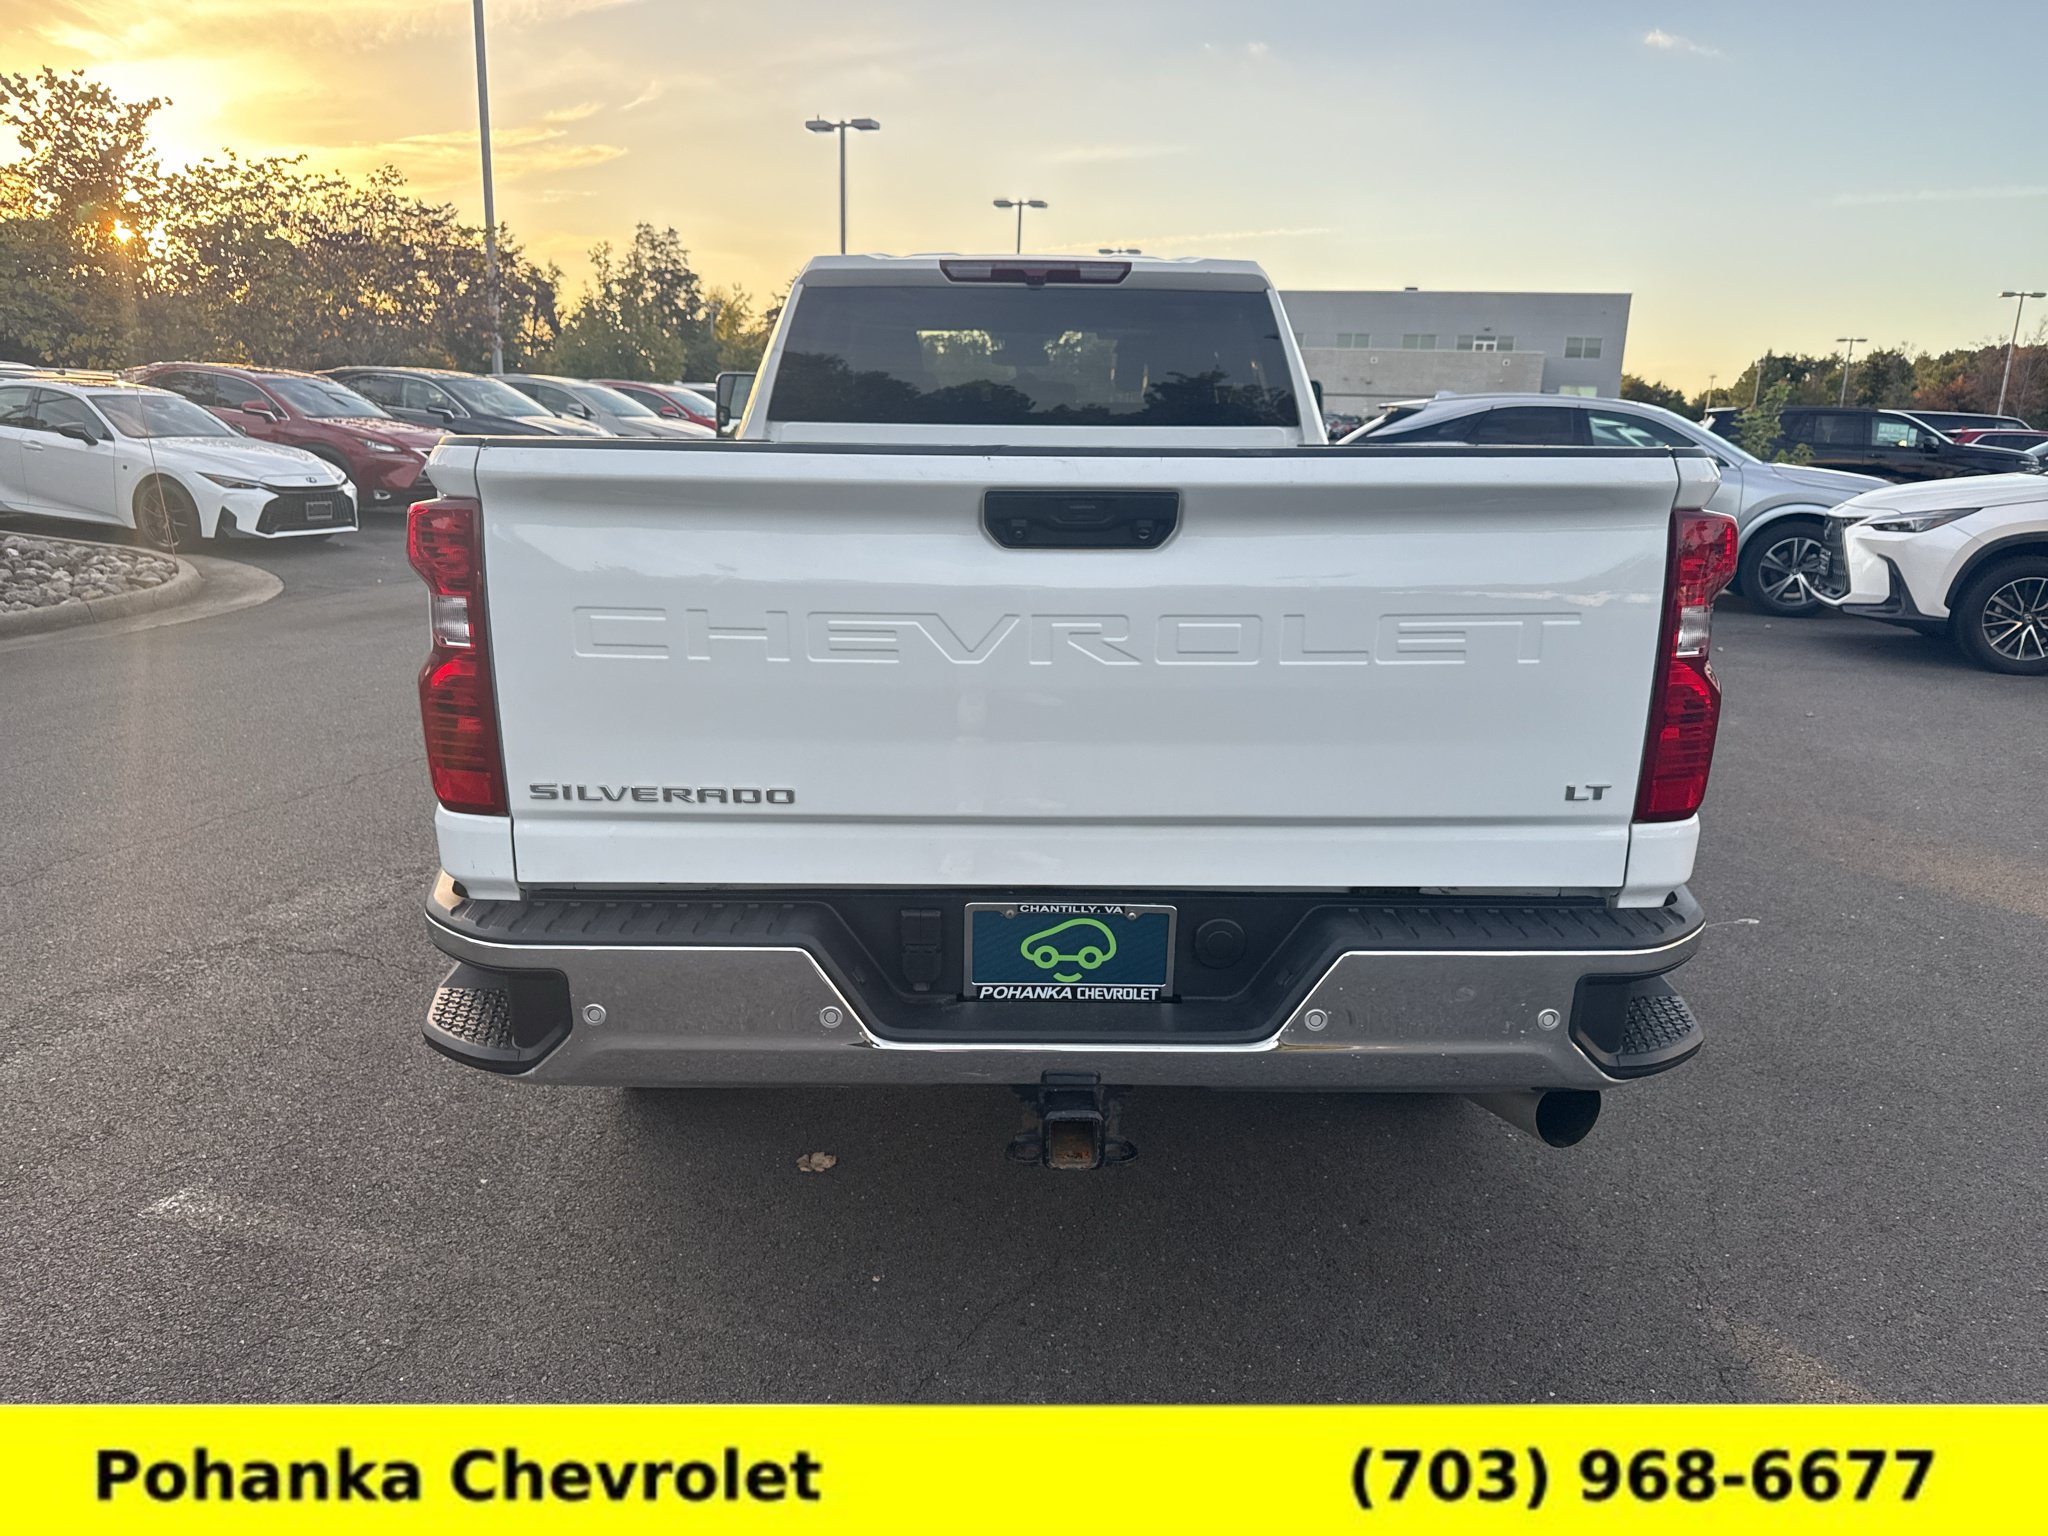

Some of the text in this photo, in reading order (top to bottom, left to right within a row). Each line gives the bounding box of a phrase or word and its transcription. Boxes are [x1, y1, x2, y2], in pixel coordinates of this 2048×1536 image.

[572, 606, 1582, 666] CHEVROLET
[529, 783, 796, 804] SILVERADO
[1564, 784, 1612, 801] LT
[1019, 904, 1124, 914] CHANTILLY, VA
[979, 986, 1159, 1001] POHANKA CHEVROLET
